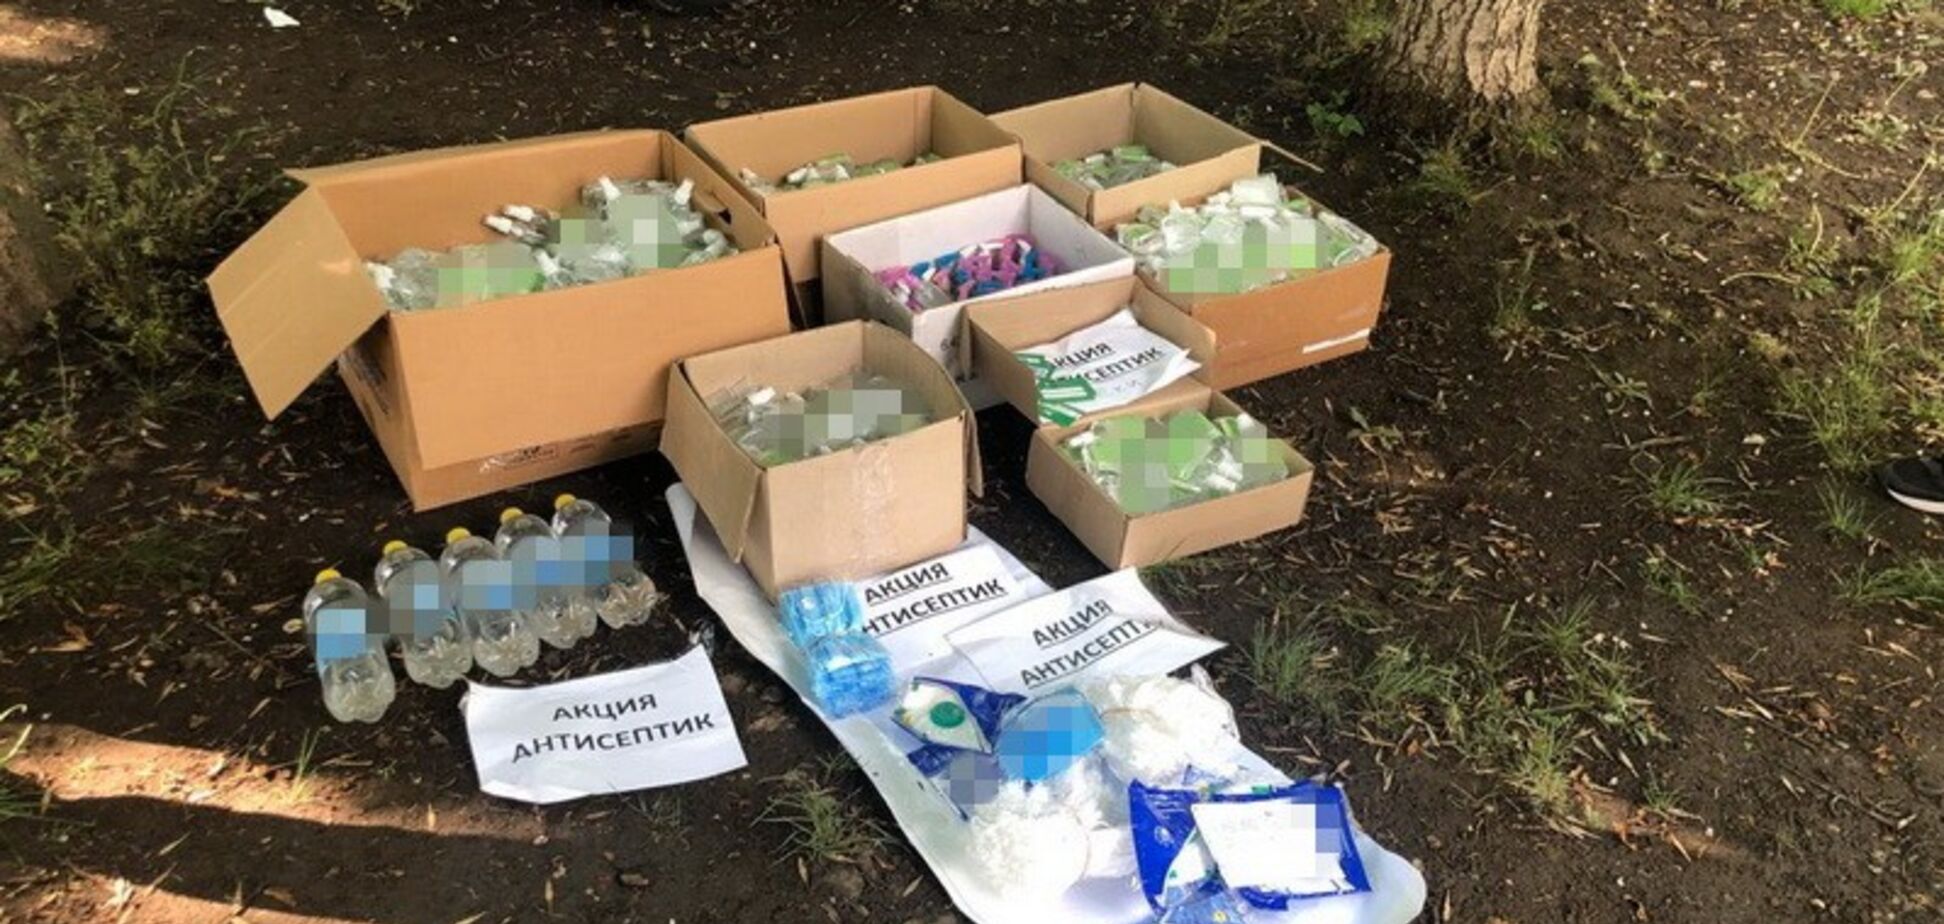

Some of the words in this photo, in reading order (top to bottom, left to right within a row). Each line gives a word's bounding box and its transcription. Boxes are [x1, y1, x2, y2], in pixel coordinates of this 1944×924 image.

[1053, 342, 1112, 368] КЦИЯ
[864, 562, 949, 603] АКЦИЯ
[861, 578, 1005, 634] НТИСЕПТИК
[1032, 599, 1113, 646] АКЦИЯ
[552, 693, 657, 721] АКЦИЯ
[512, 713, 715, 763] АНТИСЕПТИК
